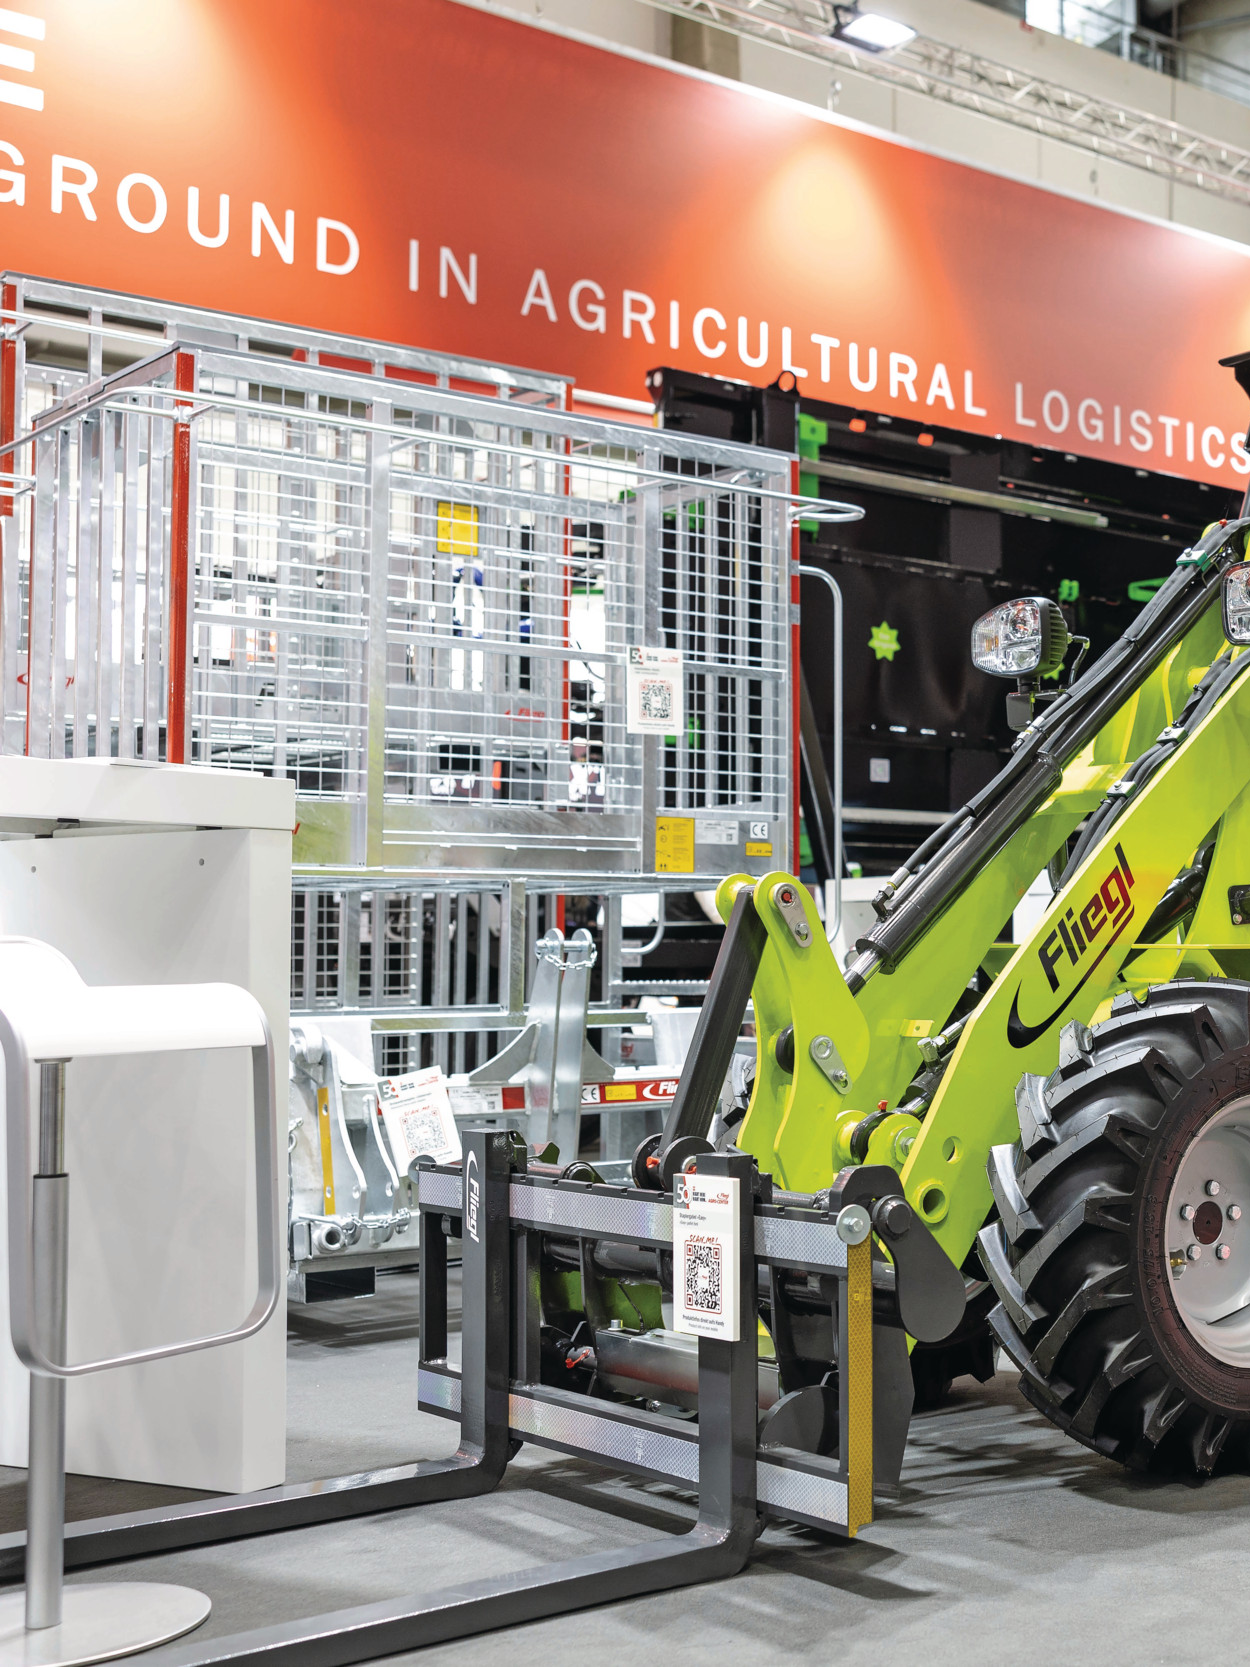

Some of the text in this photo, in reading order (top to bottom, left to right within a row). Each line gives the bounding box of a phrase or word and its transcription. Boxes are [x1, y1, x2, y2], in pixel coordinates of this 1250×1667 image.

[408, 239, 478, 304] IN
[521, 268, 988, 417] AGRICULTURAL
[752, 824, 766, 836] CE
[1038, 842, 1135, 993] Fliegl
[467, 1177, 480, 1245] Fliegl
